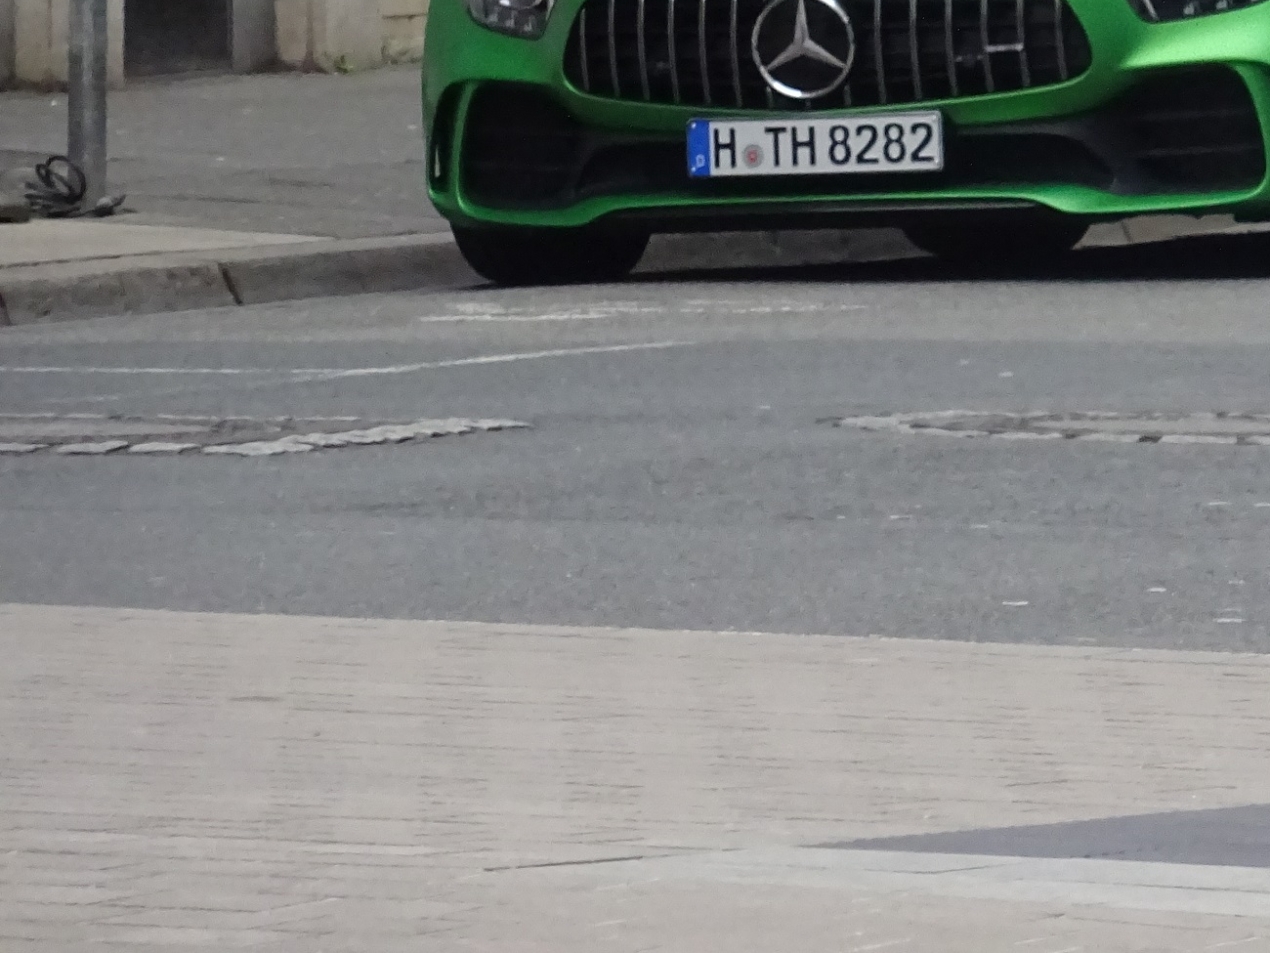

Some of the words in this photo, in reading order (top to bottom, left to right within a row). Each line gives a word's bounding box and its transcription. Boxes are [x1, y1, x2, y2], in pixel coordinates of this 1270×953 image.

[713, 127, 737, 169] H
[764, 126, 816, 167] TH
[828, 122, 936, 165] 8282
